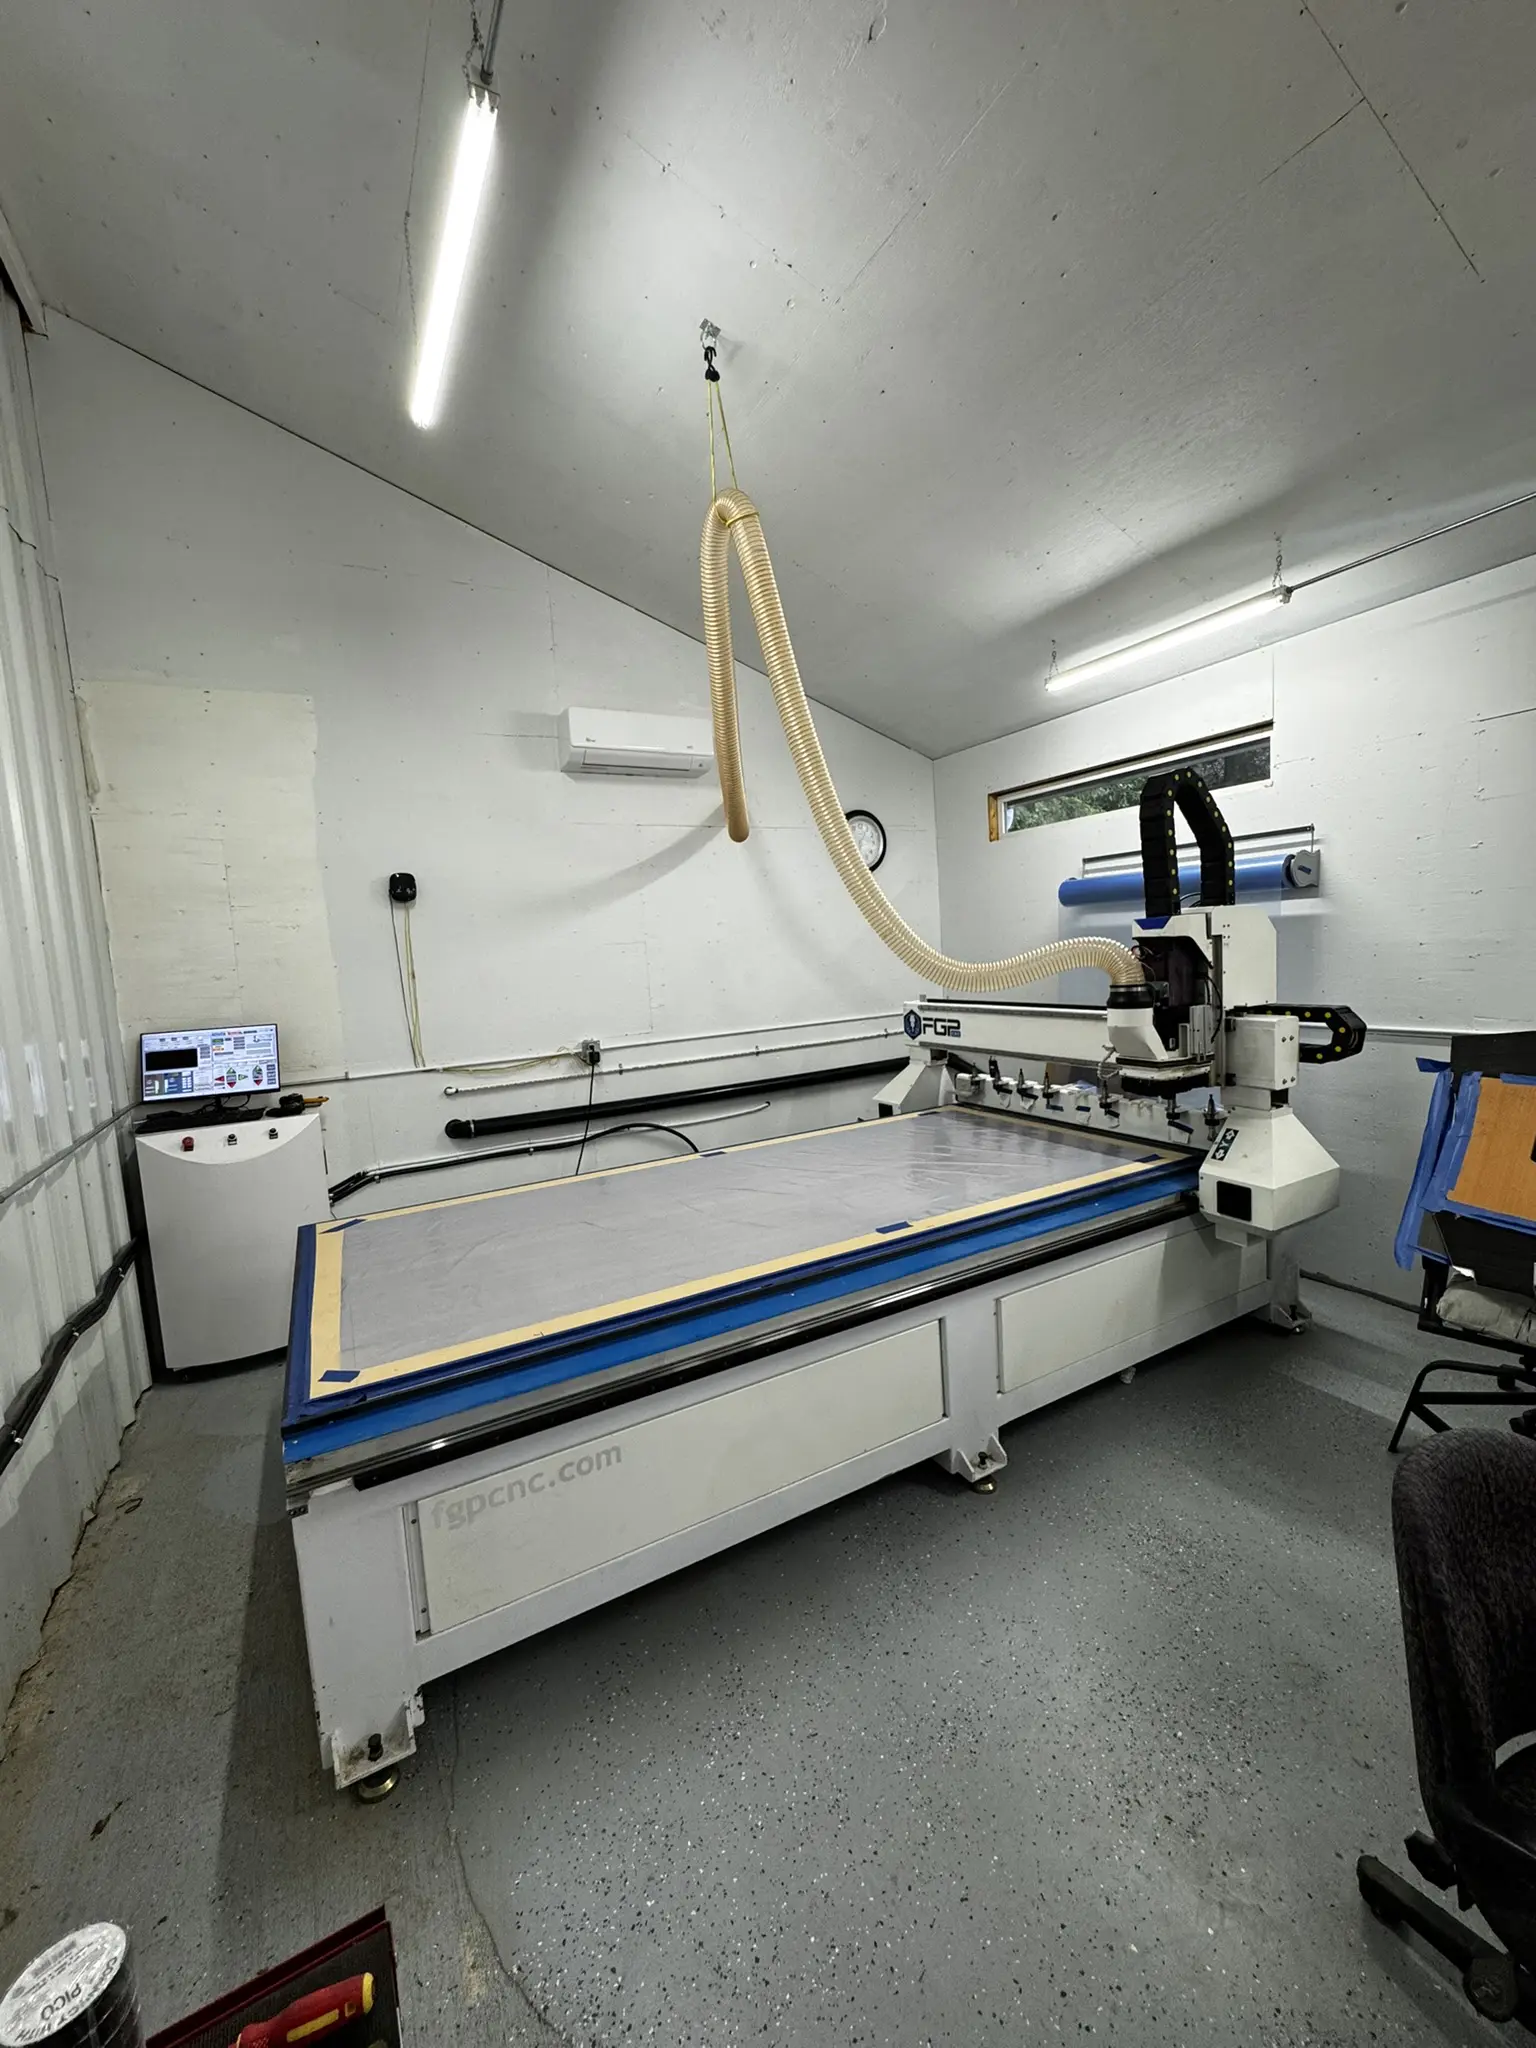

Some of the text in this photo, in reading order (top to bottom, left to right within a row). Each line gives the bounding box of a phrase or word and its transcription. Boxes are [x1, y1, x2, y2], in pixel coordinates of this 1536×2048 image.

[922, 1017, 960, 1036] FGP
[431, 1445, 622, 1530] fgpcnc.com
[41, 1983, 81, 2020] PICO
